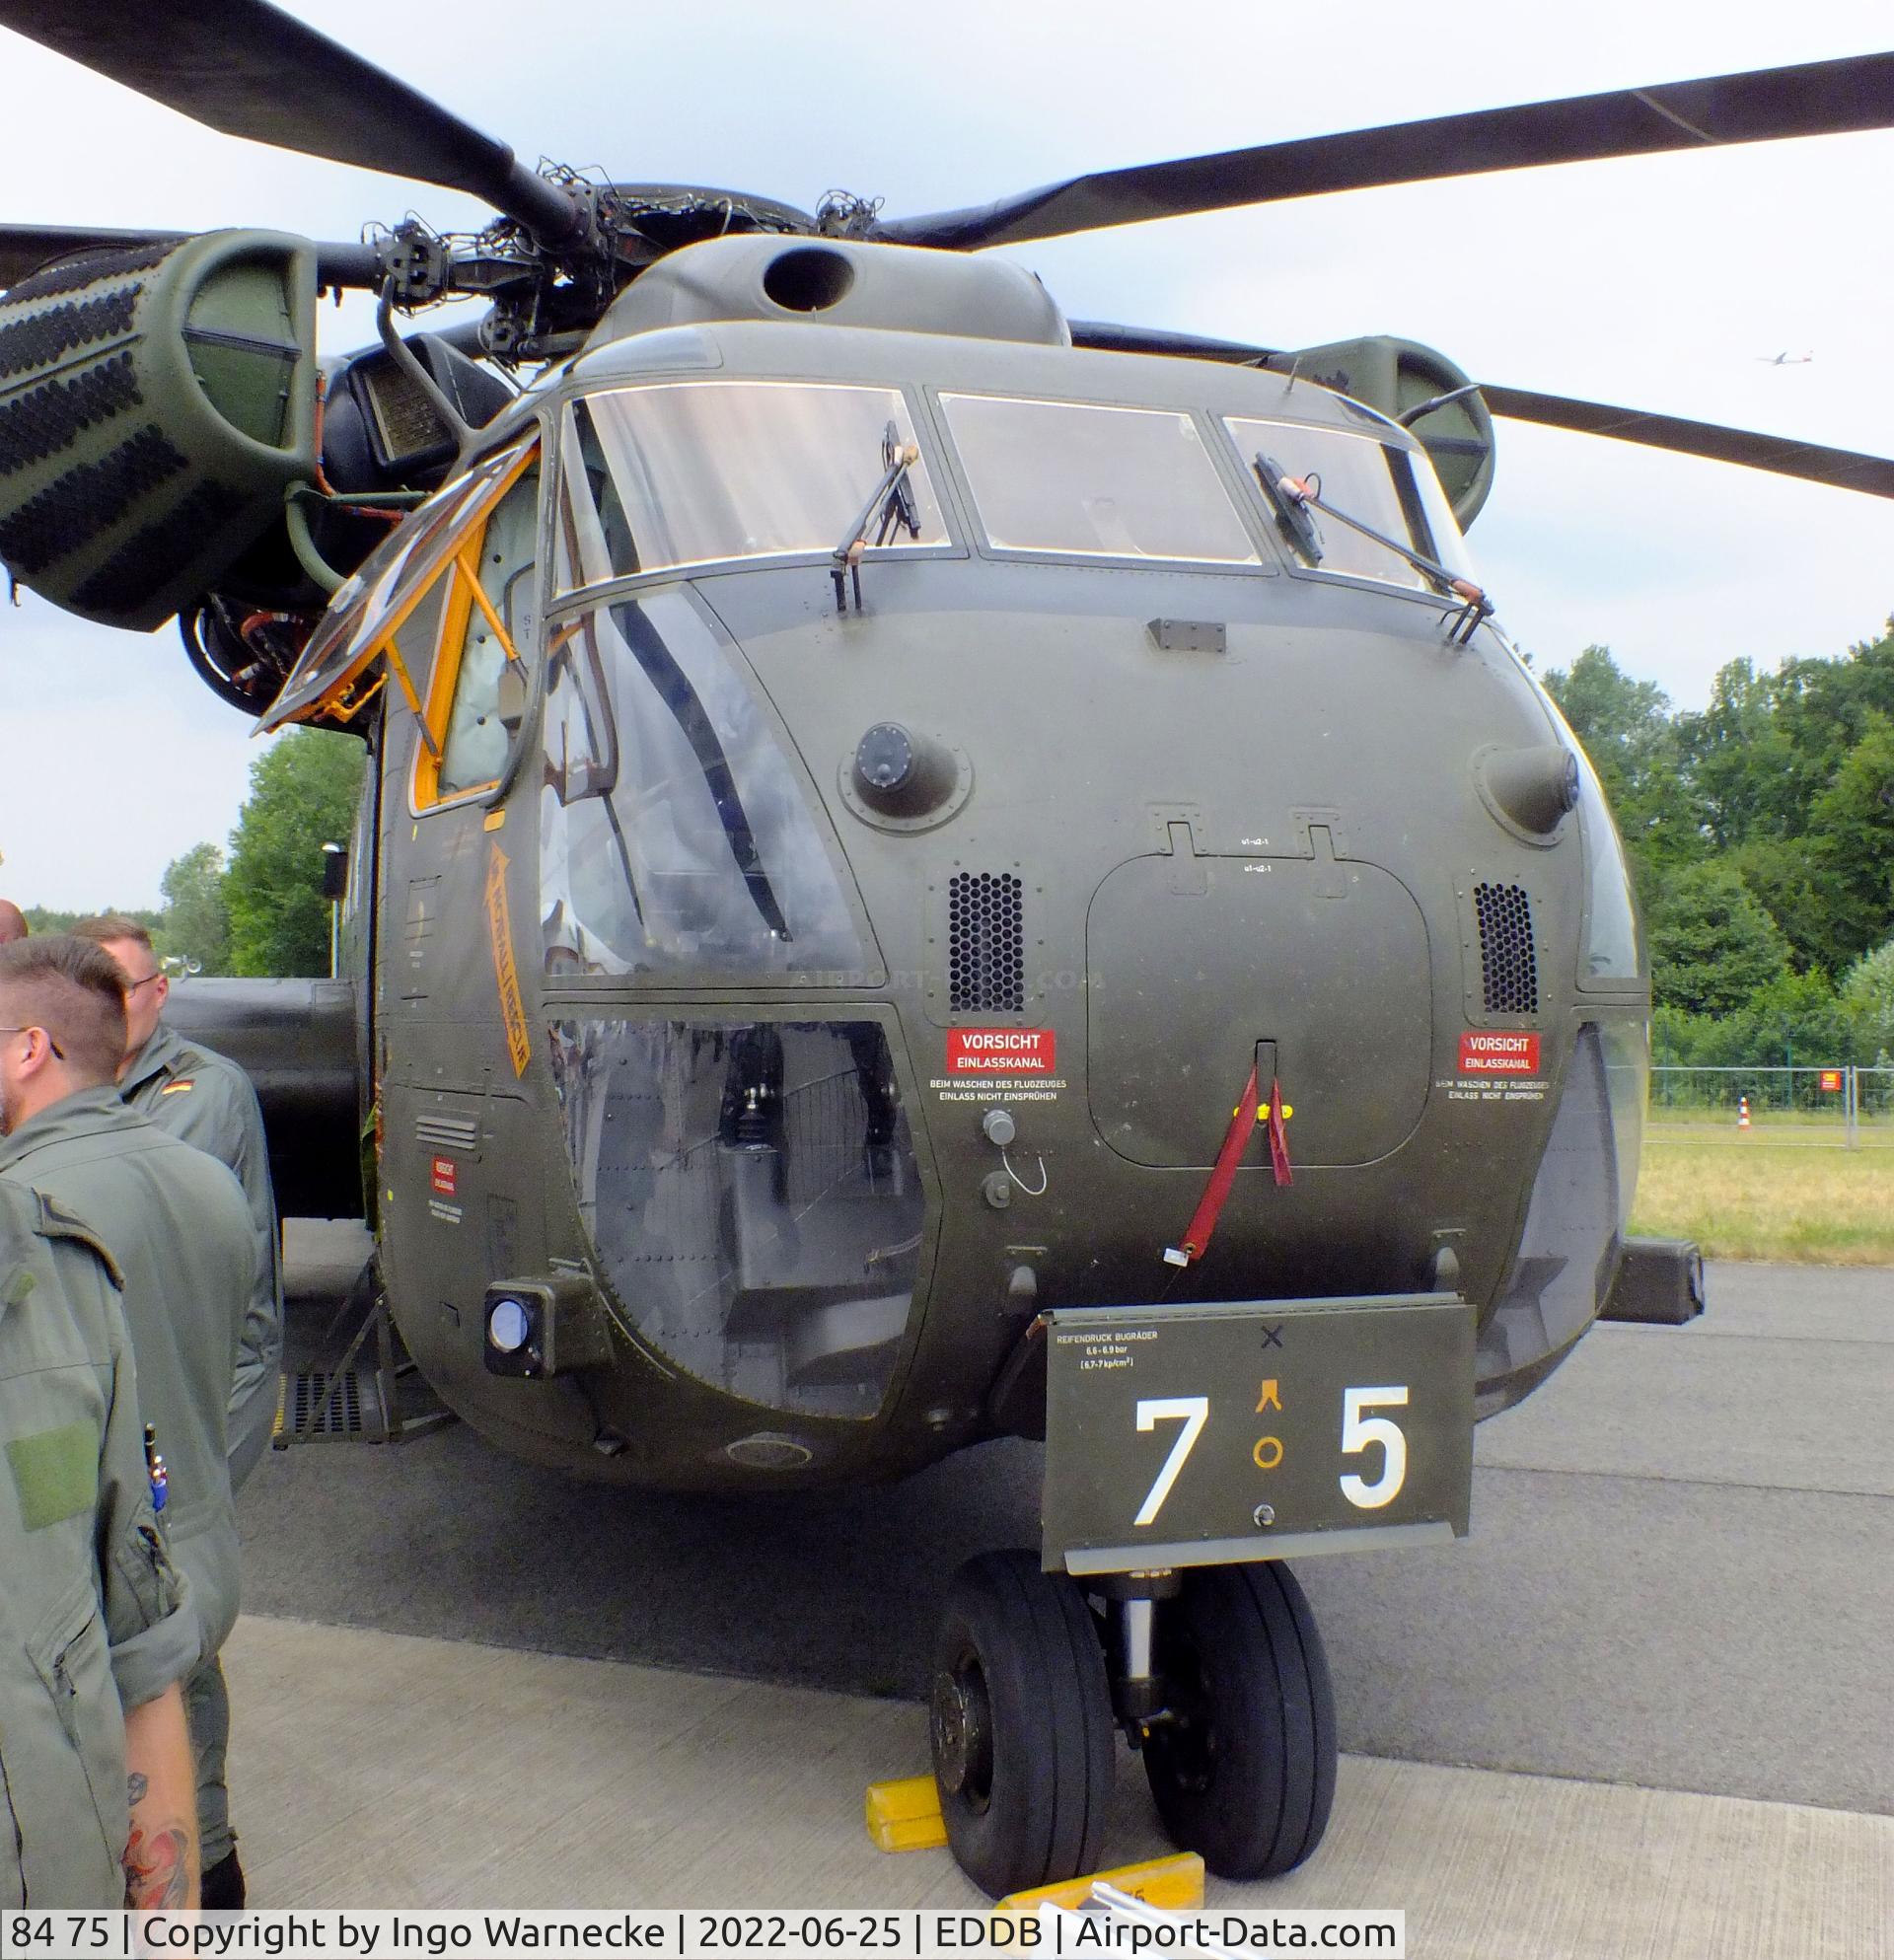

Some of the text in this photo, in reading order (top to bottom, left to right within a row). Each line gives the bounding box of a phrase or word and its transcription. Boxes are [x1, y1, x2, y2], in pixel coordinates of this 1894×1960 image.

[962, 1034, 1041, 1050] VORSICHT
[1470, 1037, 1530, 1052] VORSICHT
[957, 1056, 1046, 1068] EINLASSKANAL
[1465, 1057, 1531, 1069] EINLASSKANAL
[930, 1079, 1067, 1089] BEIM WASCHEN DES FLUGZEUGES
[939, 1091, 1057, 1101] EINLASS NICHT EINSPRÜHEN
[1448, 1090, 1479, 1100] EINLASS
[1056, 1330, 1158, 1344] REIFENDRUCK BUGRÄDER
[1134, 1386, 1409, 1526] 7 5
